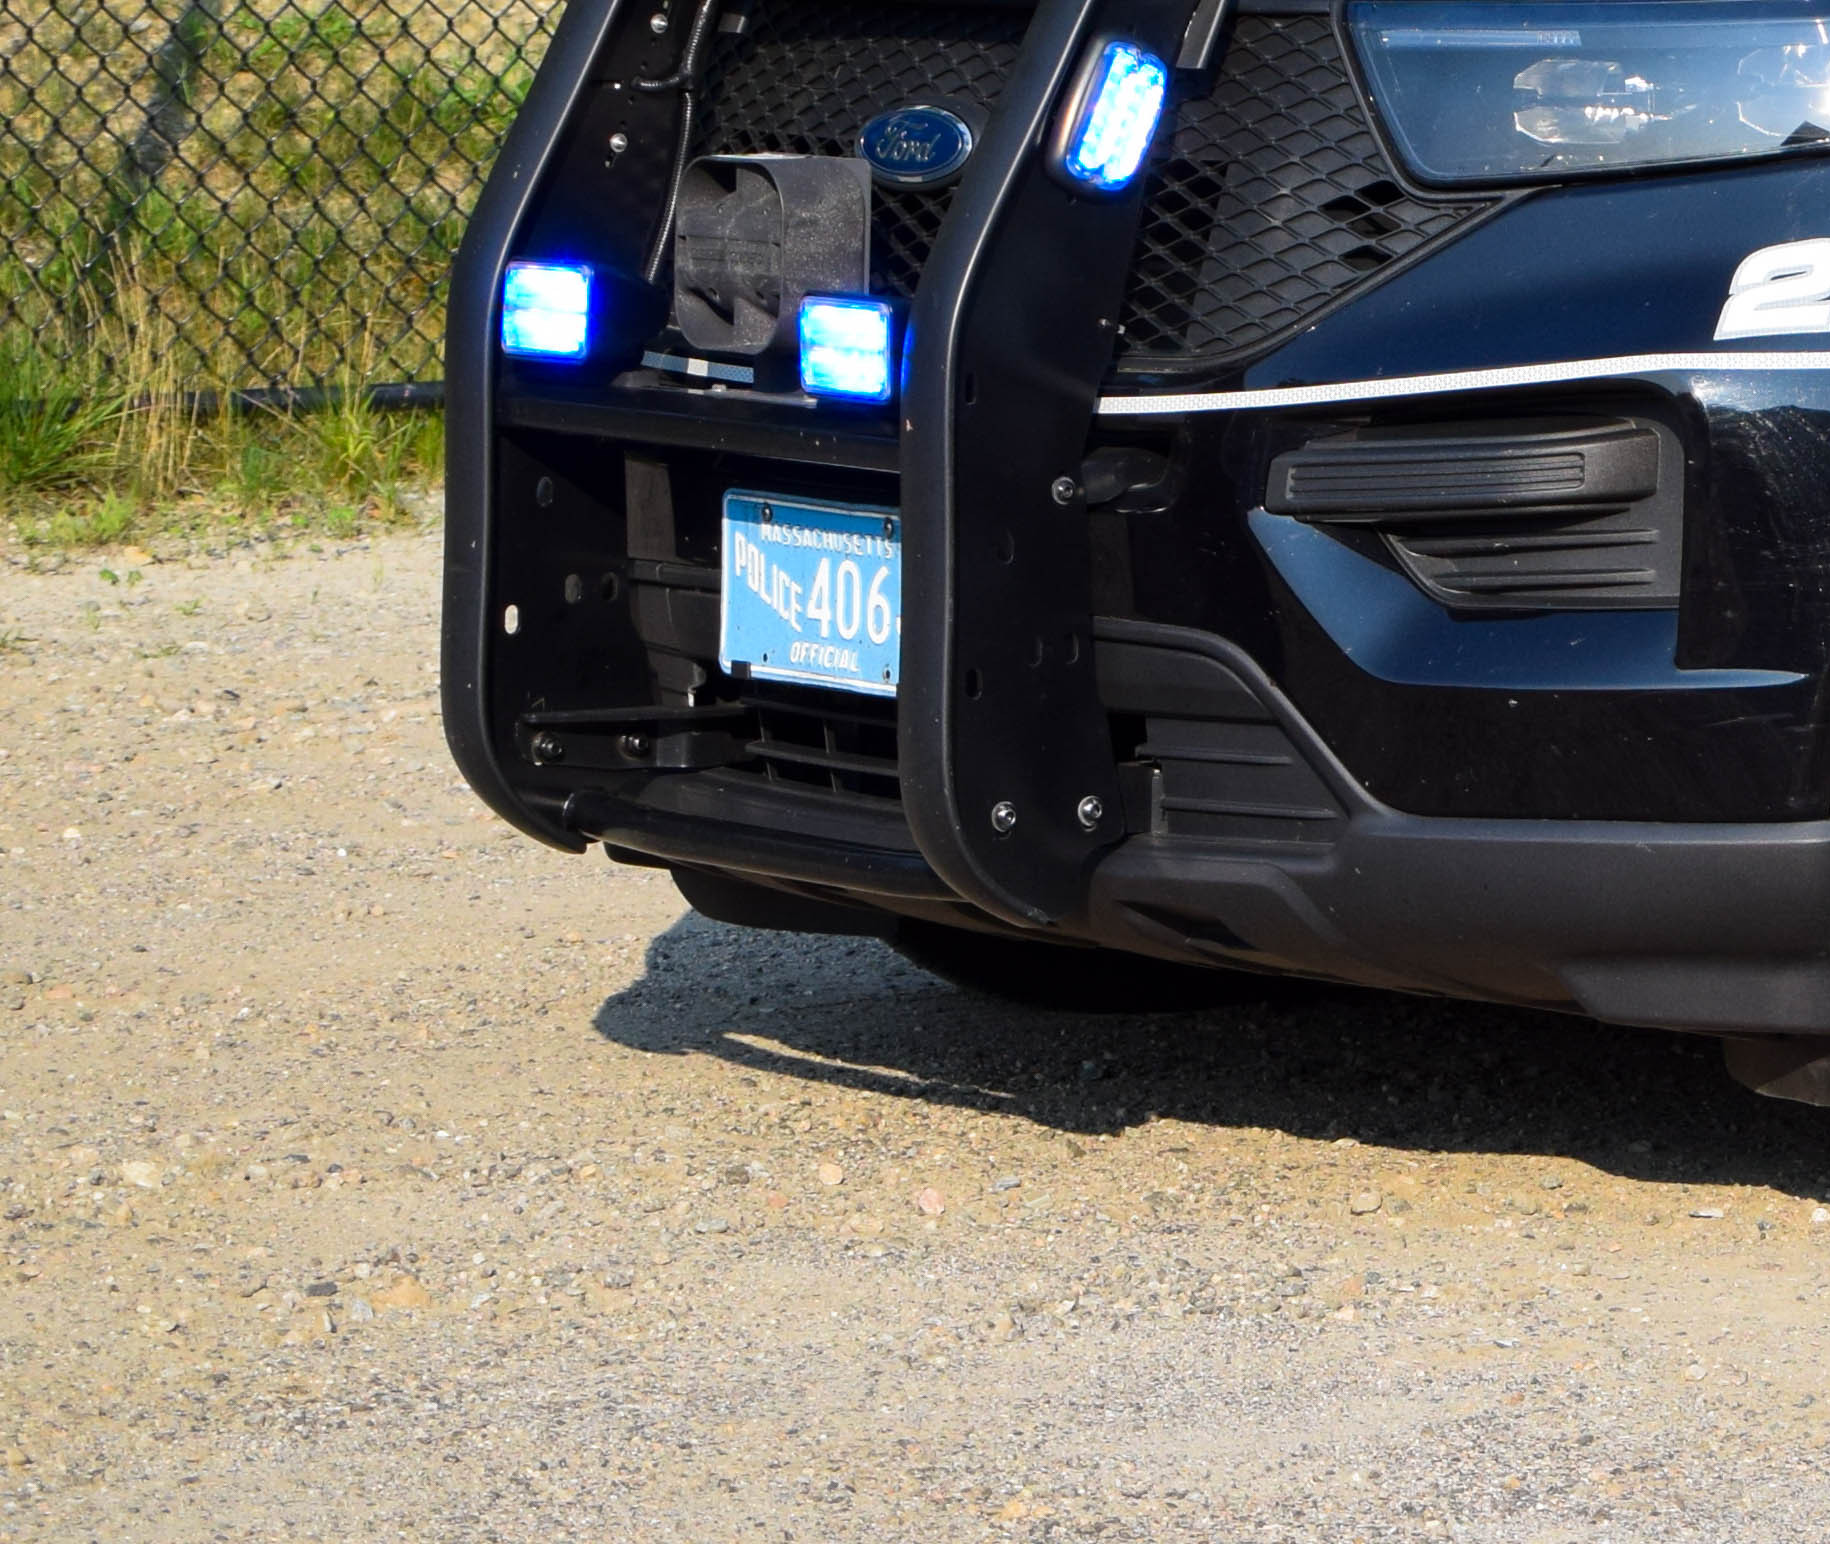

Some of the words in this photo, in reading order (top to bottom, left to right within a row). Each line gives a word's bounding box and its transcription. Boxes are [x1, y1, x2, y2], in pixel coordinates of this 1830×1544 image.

[875, 114, 942, 162] Ford
[760, 521, 893, 559] MASSACHUSETTS
[734, 531, 803, 632] POLICE
[805, 557, 900, 645] 406
[789, 640, 860, 673] OFFICIAL
